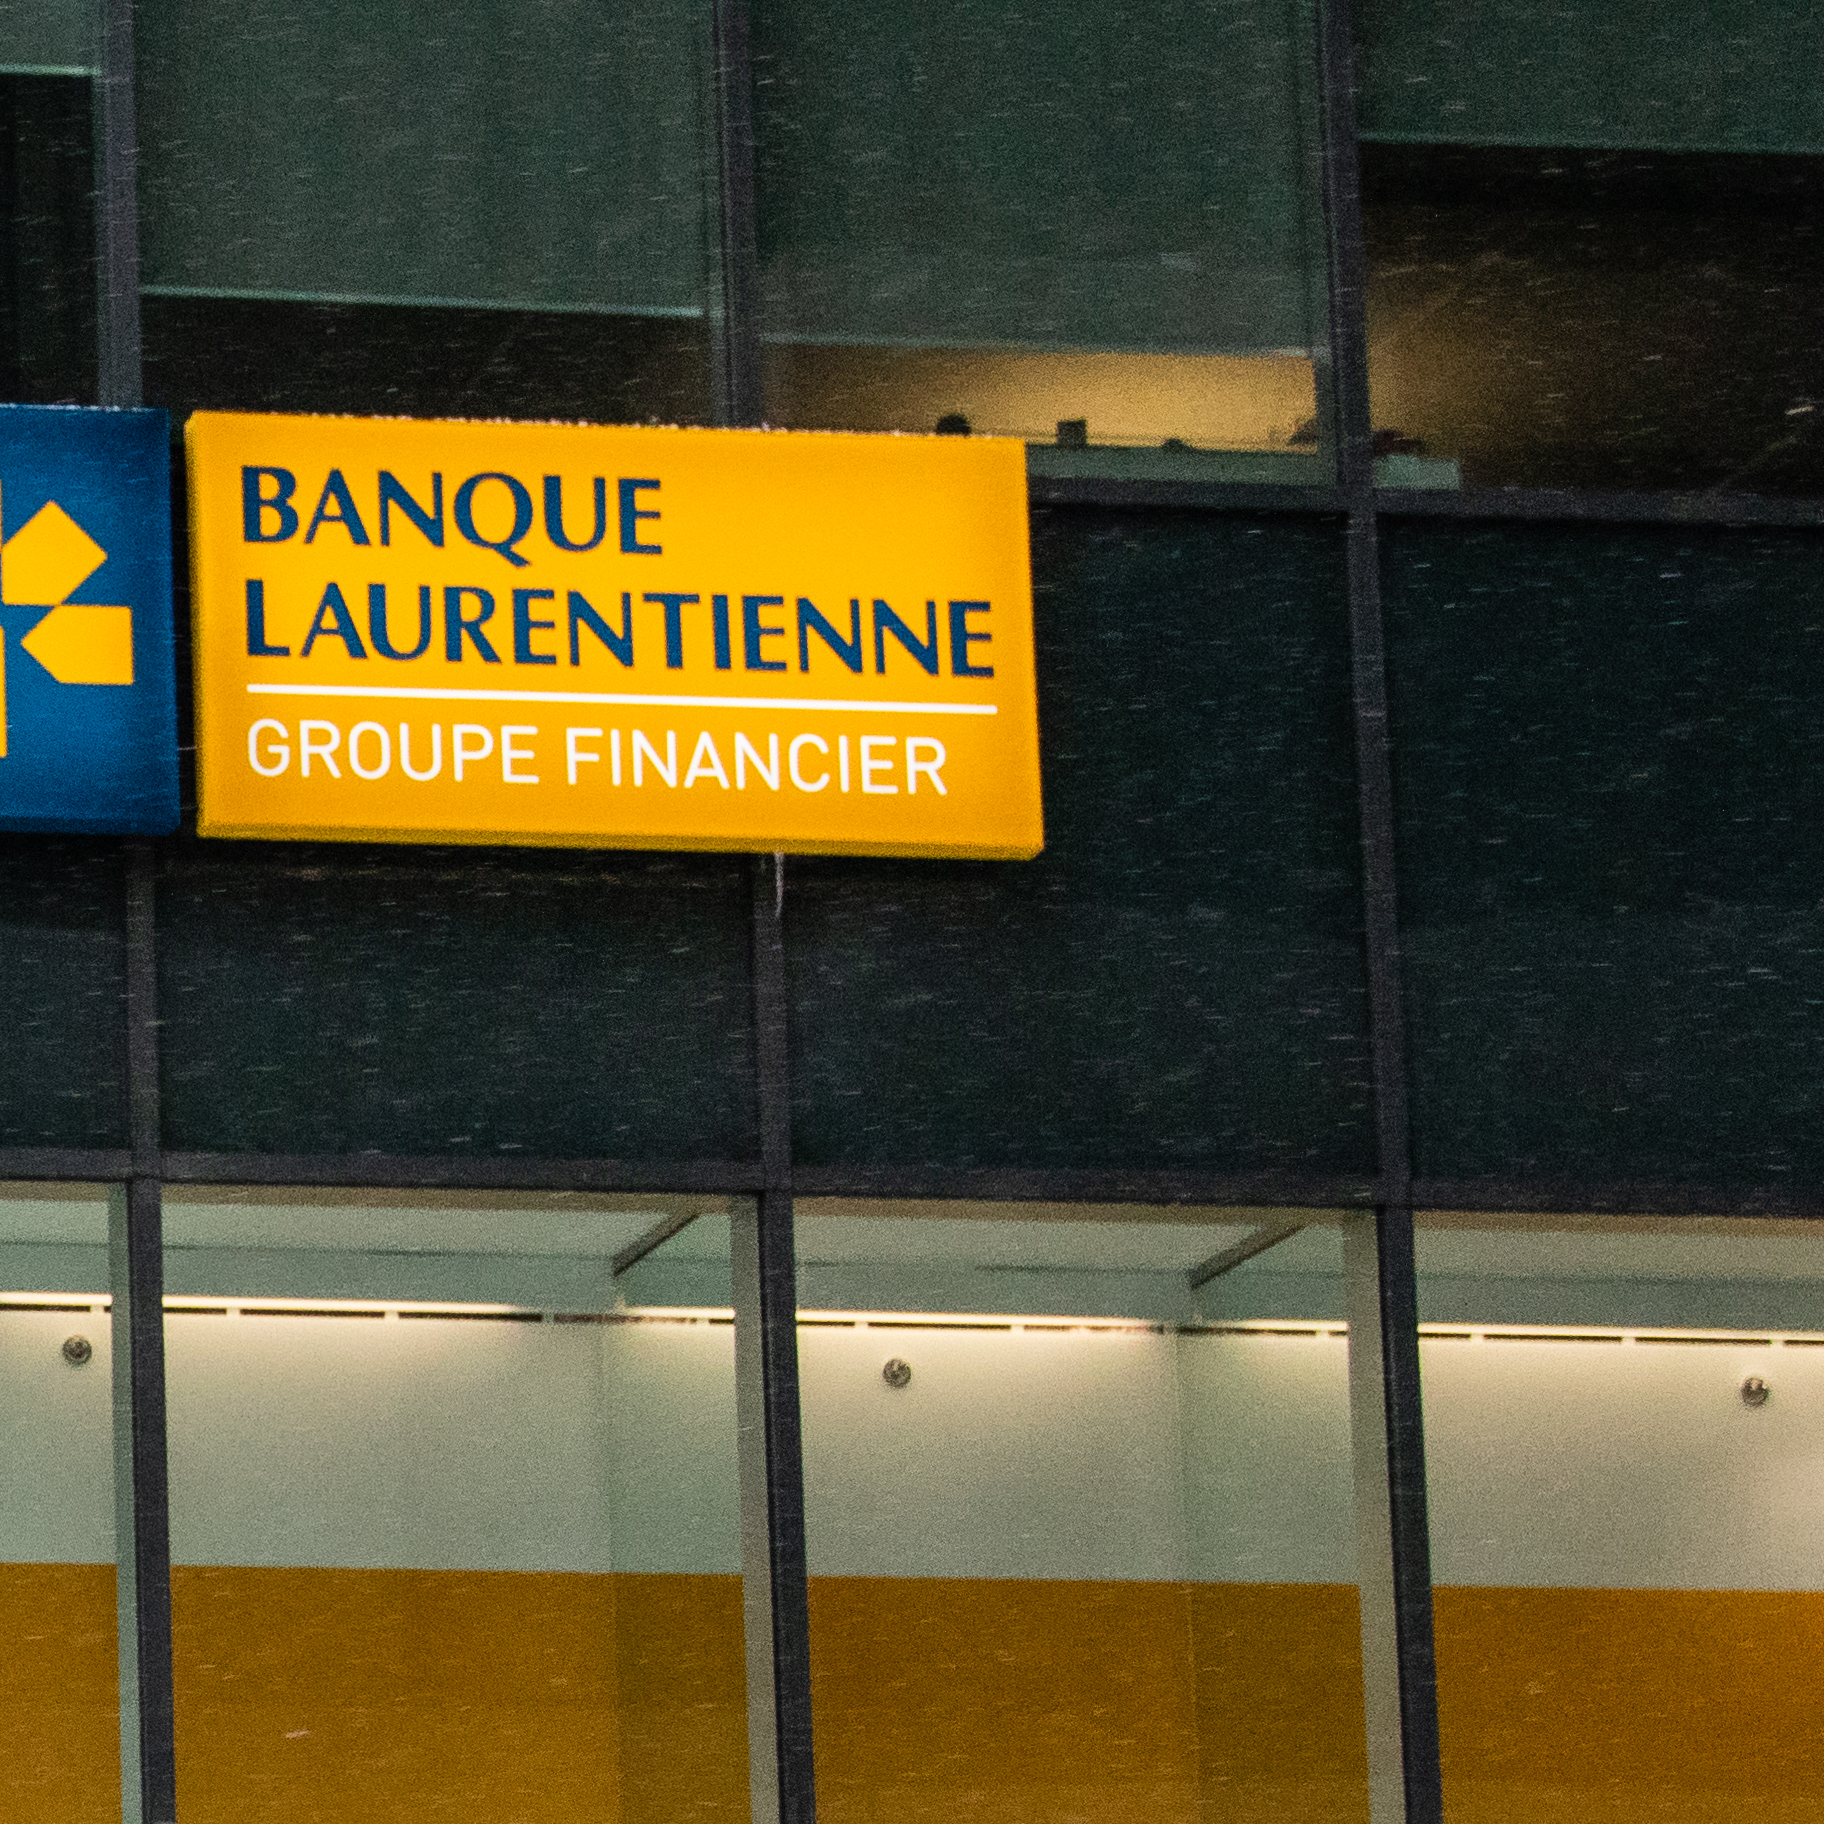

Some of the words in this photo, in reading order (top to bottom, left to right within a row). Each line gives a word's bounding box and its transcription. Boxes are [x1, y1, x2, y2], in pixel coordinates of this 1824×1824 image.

[240, 466, 662, 567] BANQUE
[245, 580, 995, 678] LAURENTIENNE
[248, 718, 539, 785] GROUPE
[567, 728, 948, 795] FINANCIER
